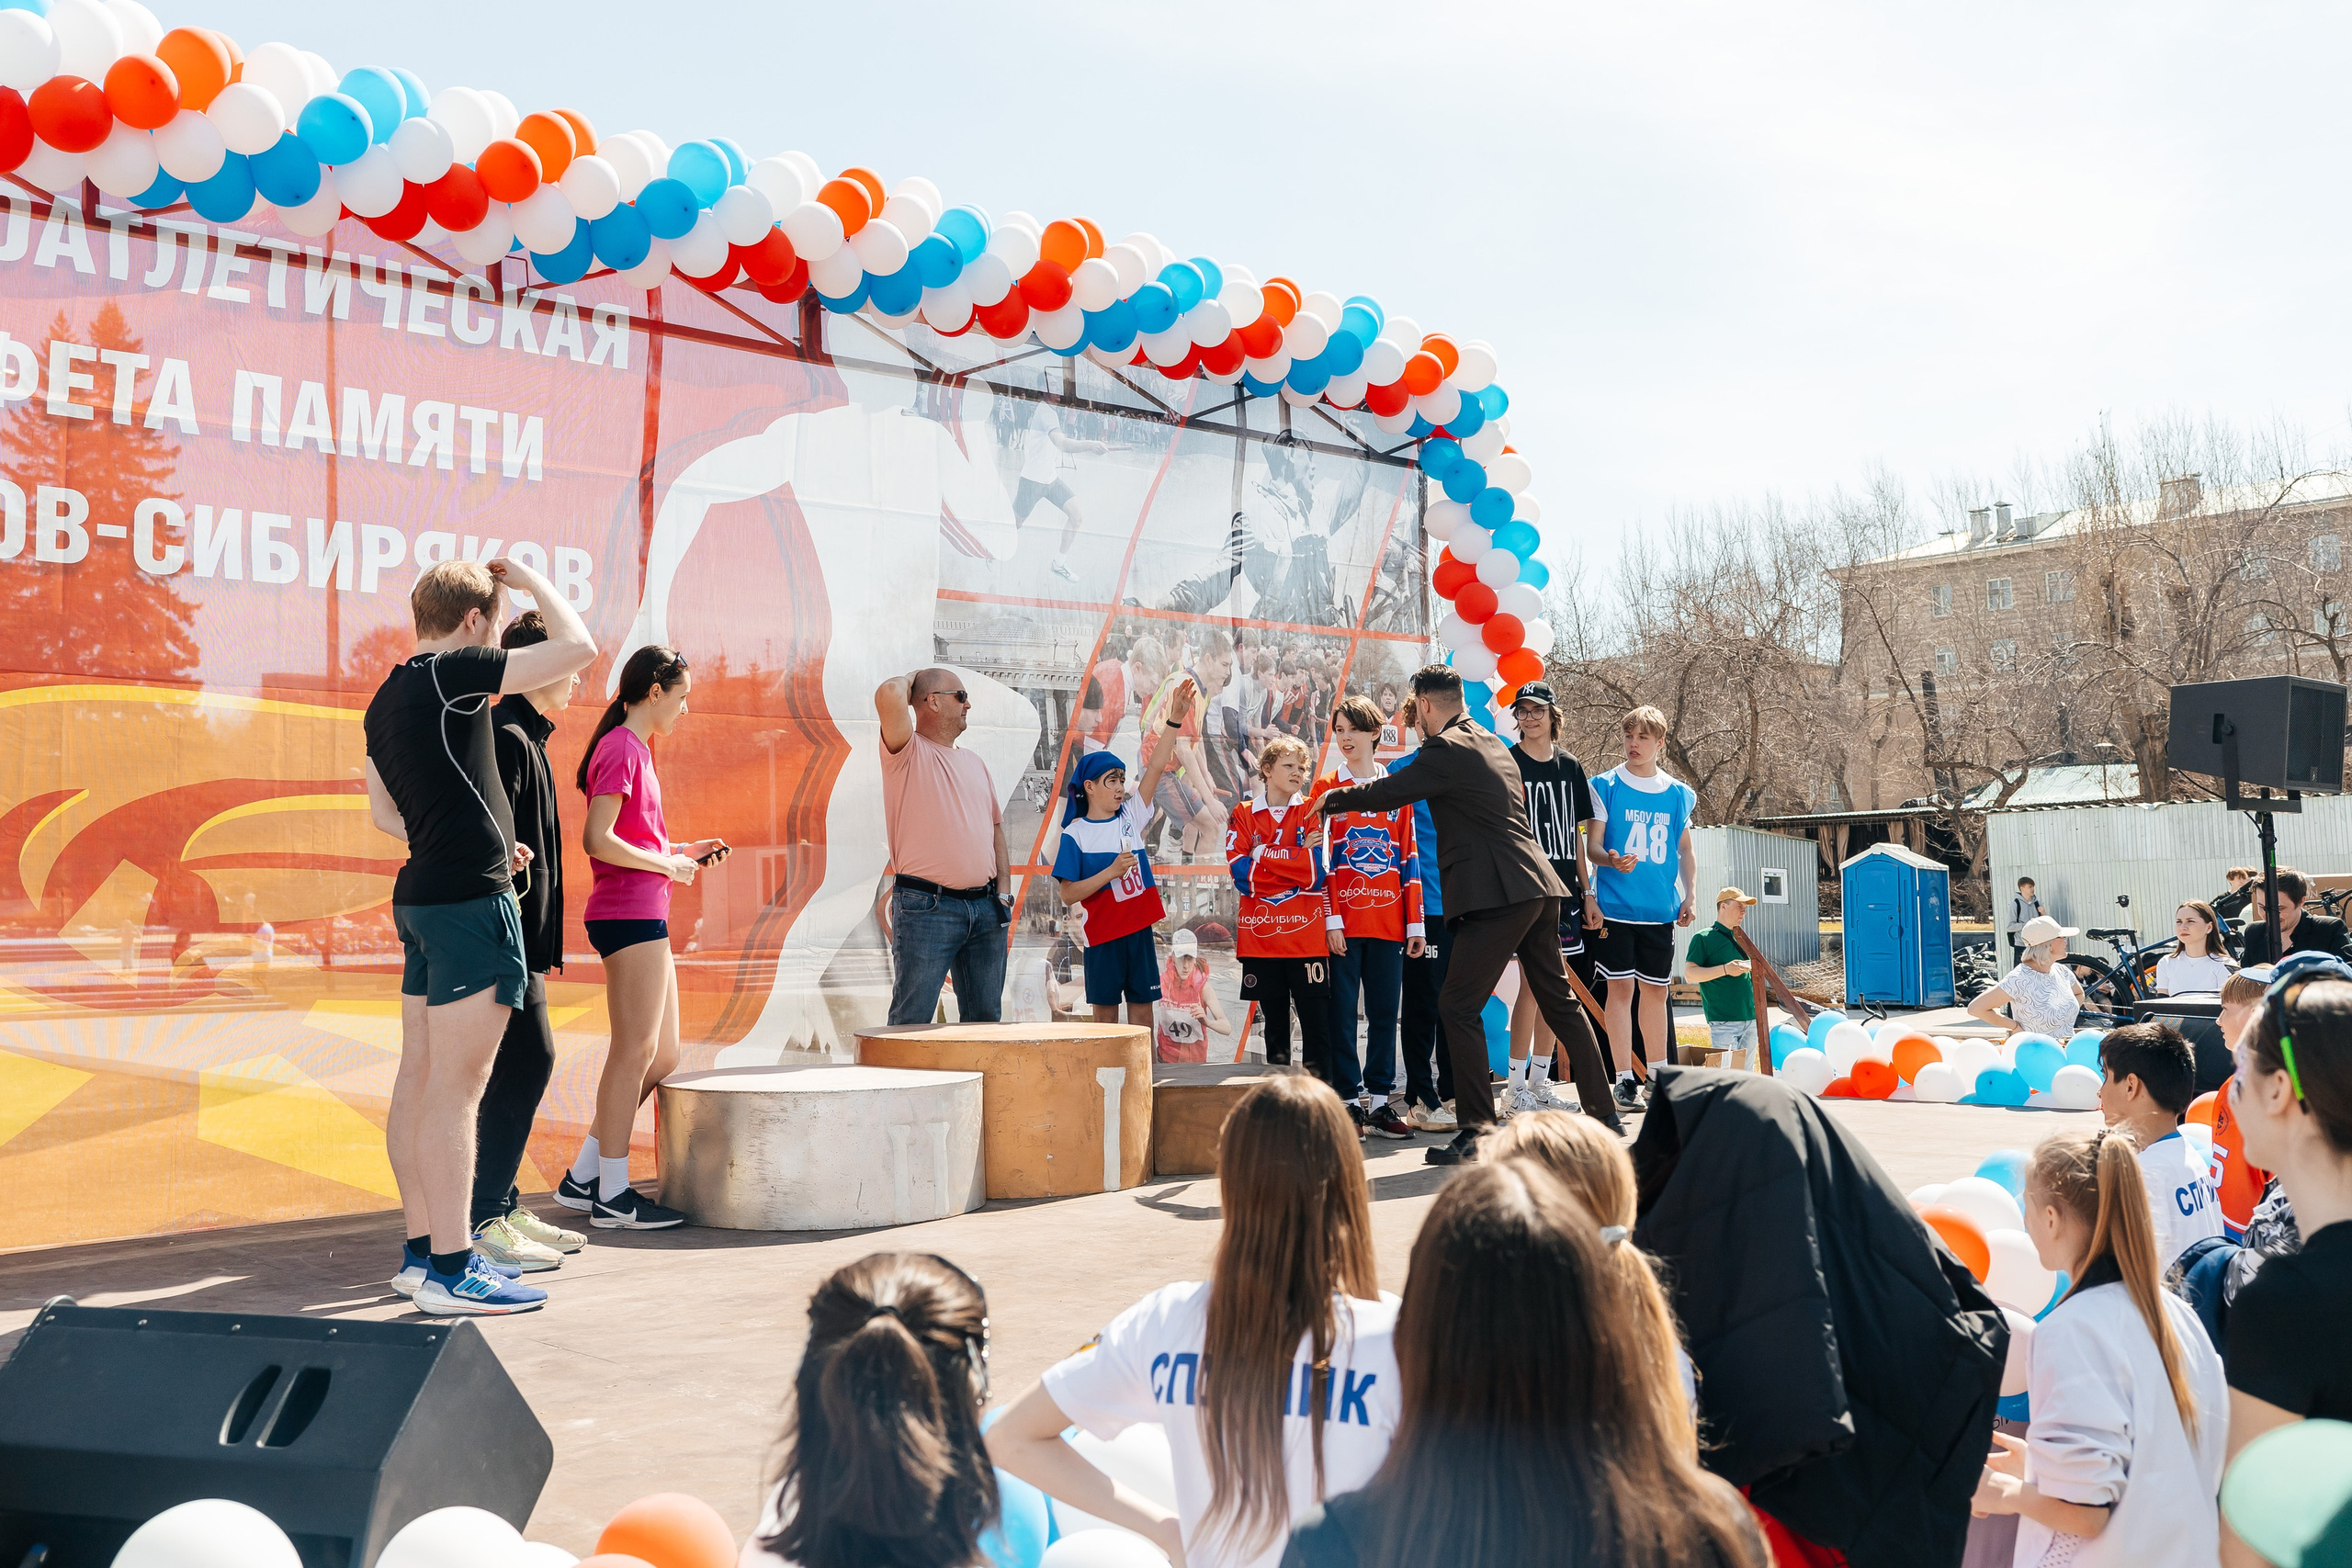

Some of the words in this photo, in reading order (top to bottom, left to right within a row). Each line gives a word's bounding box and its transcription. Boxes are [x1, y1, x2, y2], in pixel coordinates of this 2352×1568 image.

[232, 369, 543, 481] ПАМЯТИ
[1383, 728, 1396, 743] 188
[1522, 781, 1577, 861] IGMA
[1625, 809, 1652, 824] МБОУ
[1655, 812, 1670, 825] СОШ
[1274, 829, 1283, 845] 7
[1624, 822, 1668, 864] 48
[1238, 915, 1308, 924] НОВОСИБИРЬ
[1425, 945, 1438, 959] 96
[1305, 962, 1325, 984] 10
[1169, 1021, 1193, 1038] 49
[1150, 1352, 1376, 1426] СПИК
